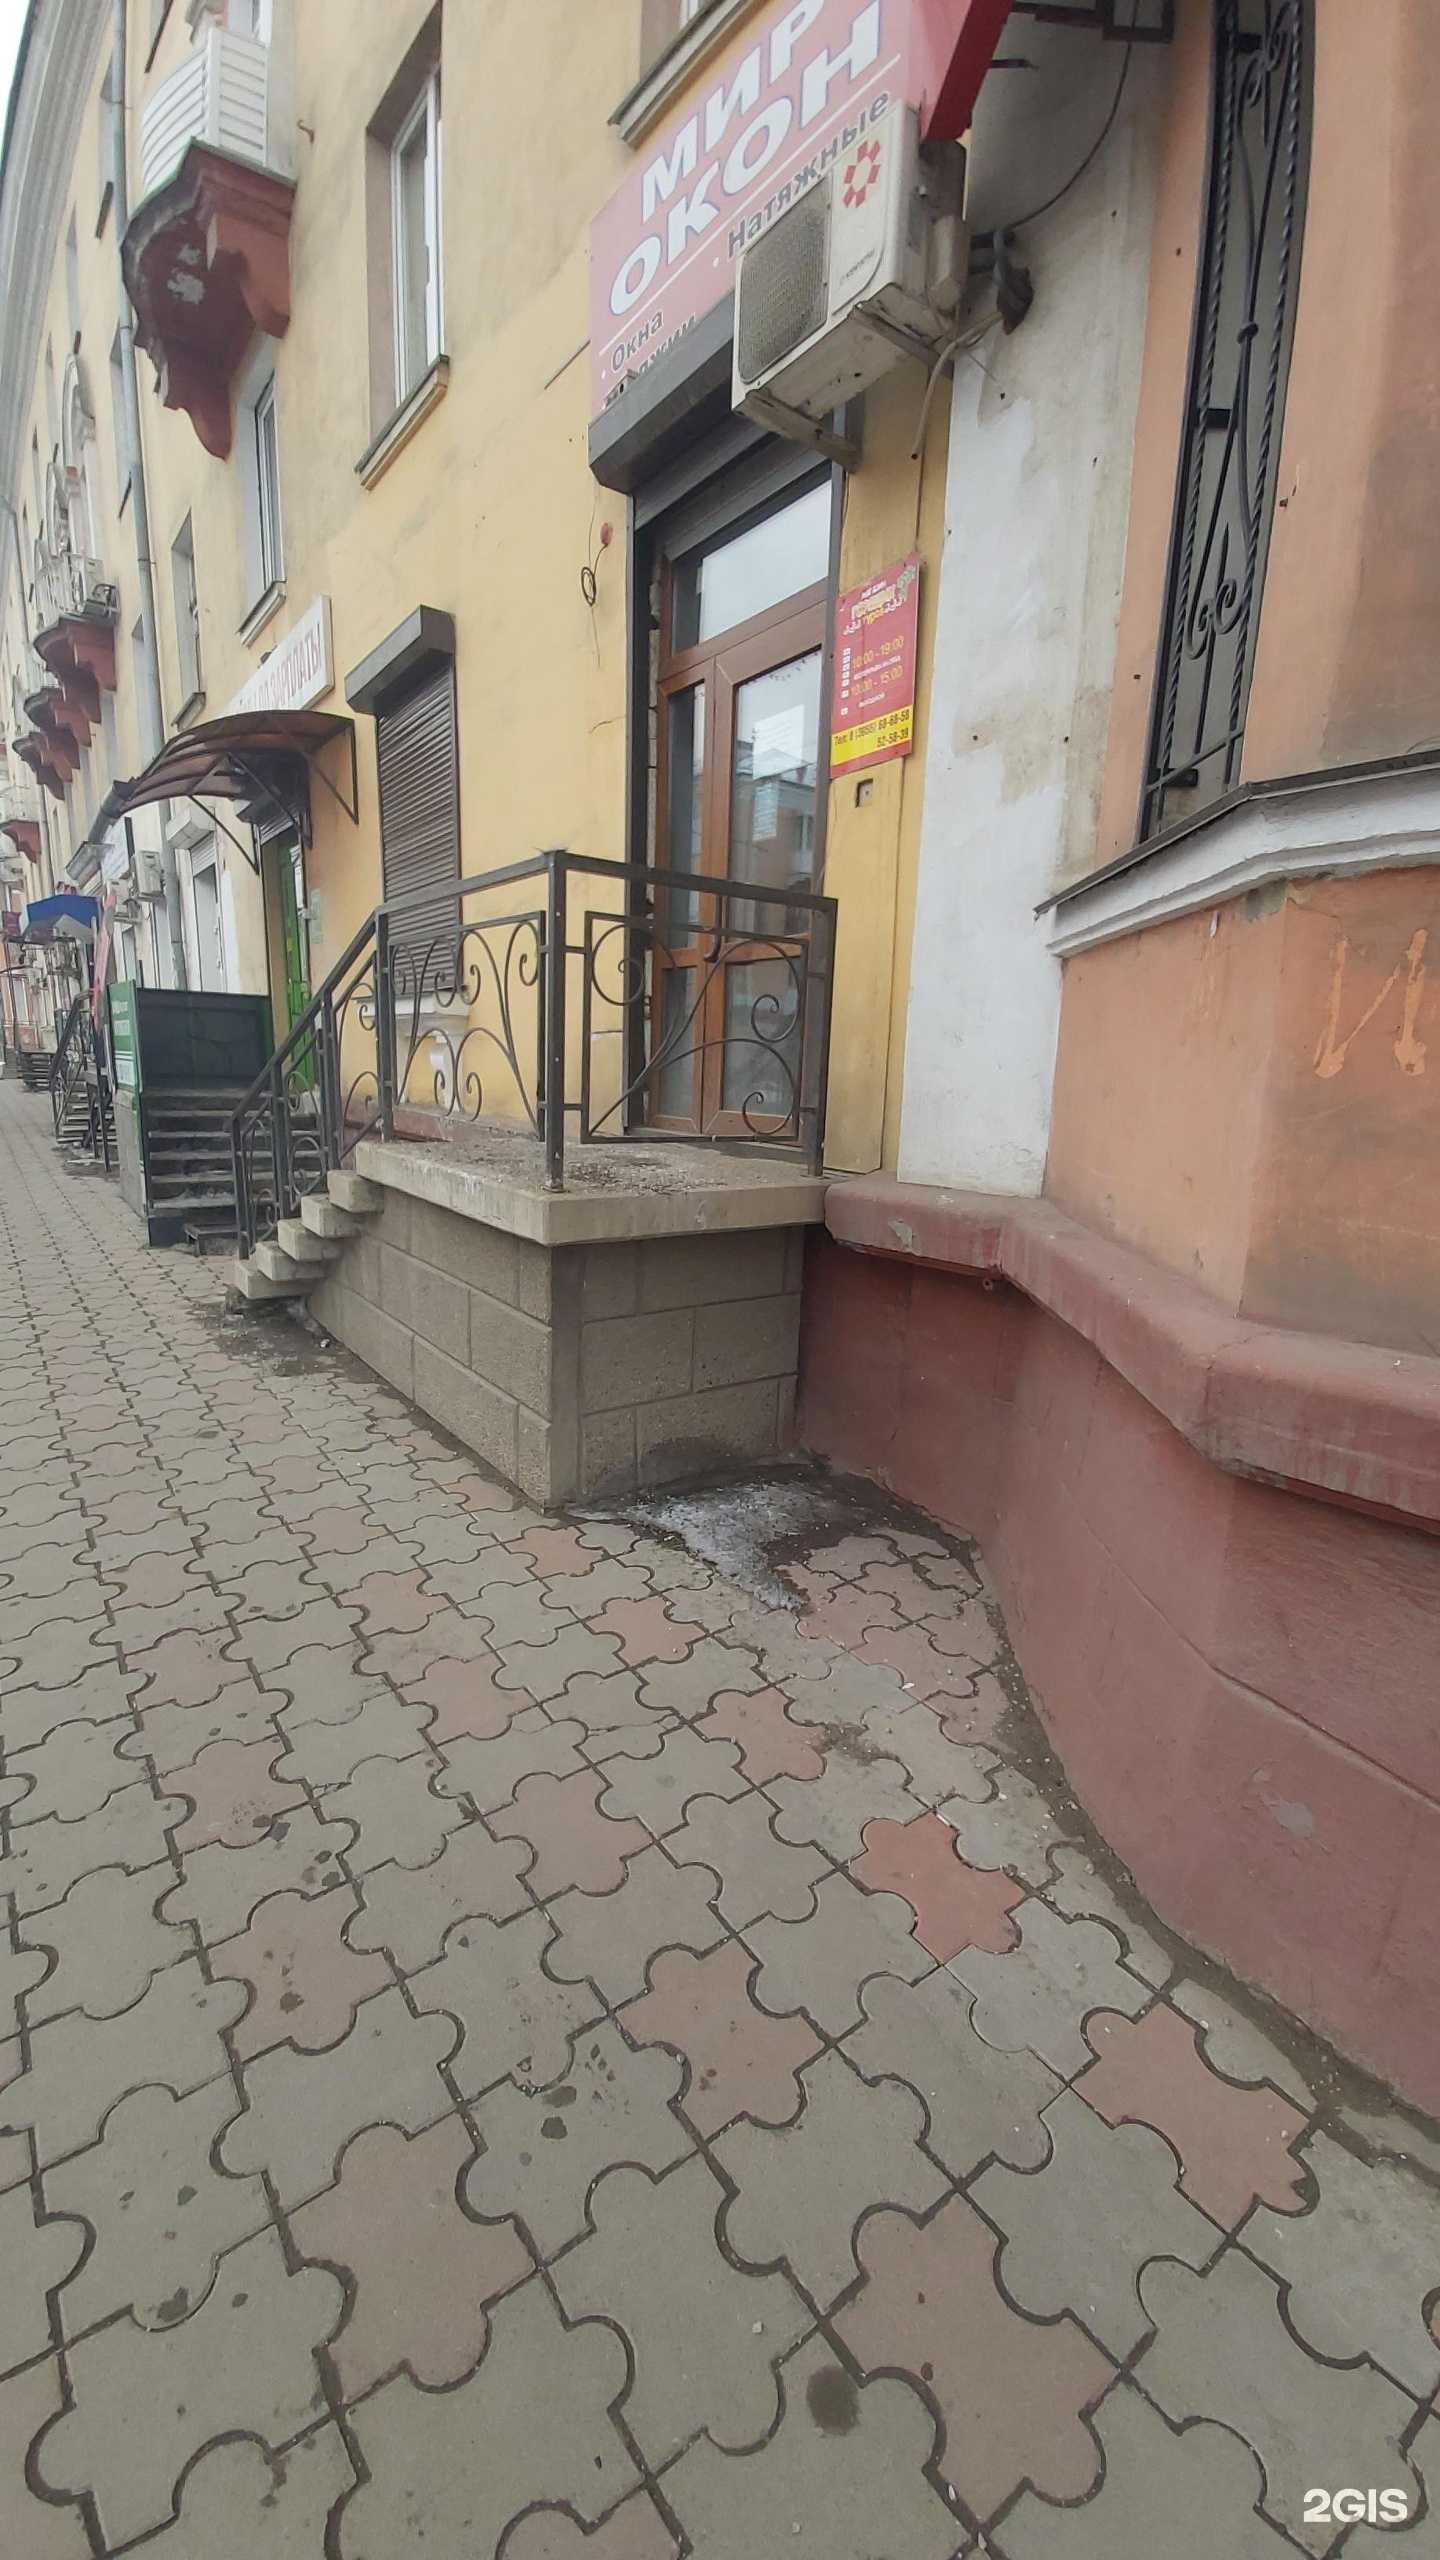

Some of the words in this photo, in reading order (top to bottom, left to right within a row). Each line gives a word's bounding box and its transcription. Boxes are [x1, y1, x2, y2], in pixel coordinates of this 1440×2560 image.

[609, 0, 880, 316] ОКОН
[641, 0, 824, 223] МИР
[727, 92, 891, 258] Натяжные
[611, 311, 663, 372] Окна
